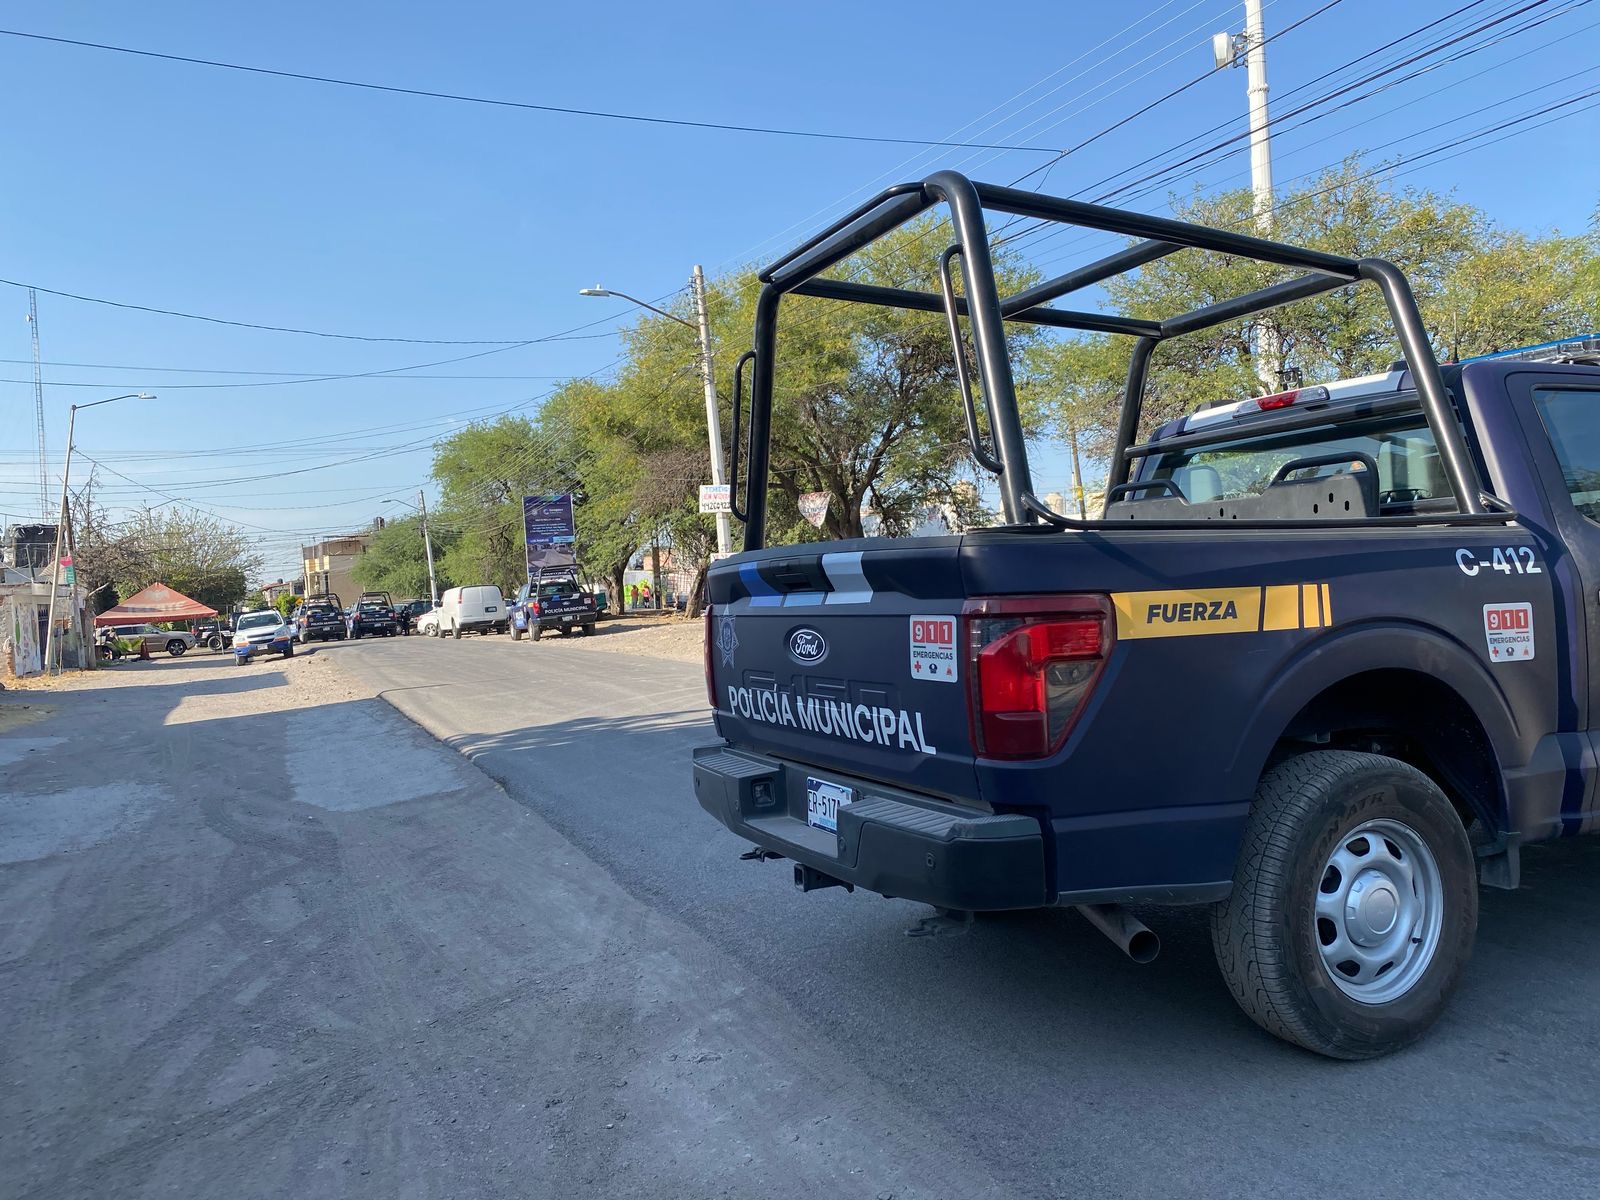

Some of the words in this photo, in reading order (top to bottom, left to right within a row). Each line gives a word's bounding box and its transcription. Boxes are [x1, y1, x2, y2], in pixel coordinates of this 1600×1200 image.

[1455, 546, 1542, 576] C-412
[1147, 600, 1238, 624] FUERZA
[1489, 611, 1526, 629] 911
[914, 623, 950, 641] 911
[1489, 636, 1530, 645] EMERGENCIAS
[793, 632, 820, 658] Ford
[912, 650, 953, 661] EMERGENCIAS
[728, 684, 797, 728] POLICÍA
[796, 695, 936, 755] MUNICIPAL
[808, 791, 840, 819] ER-517
